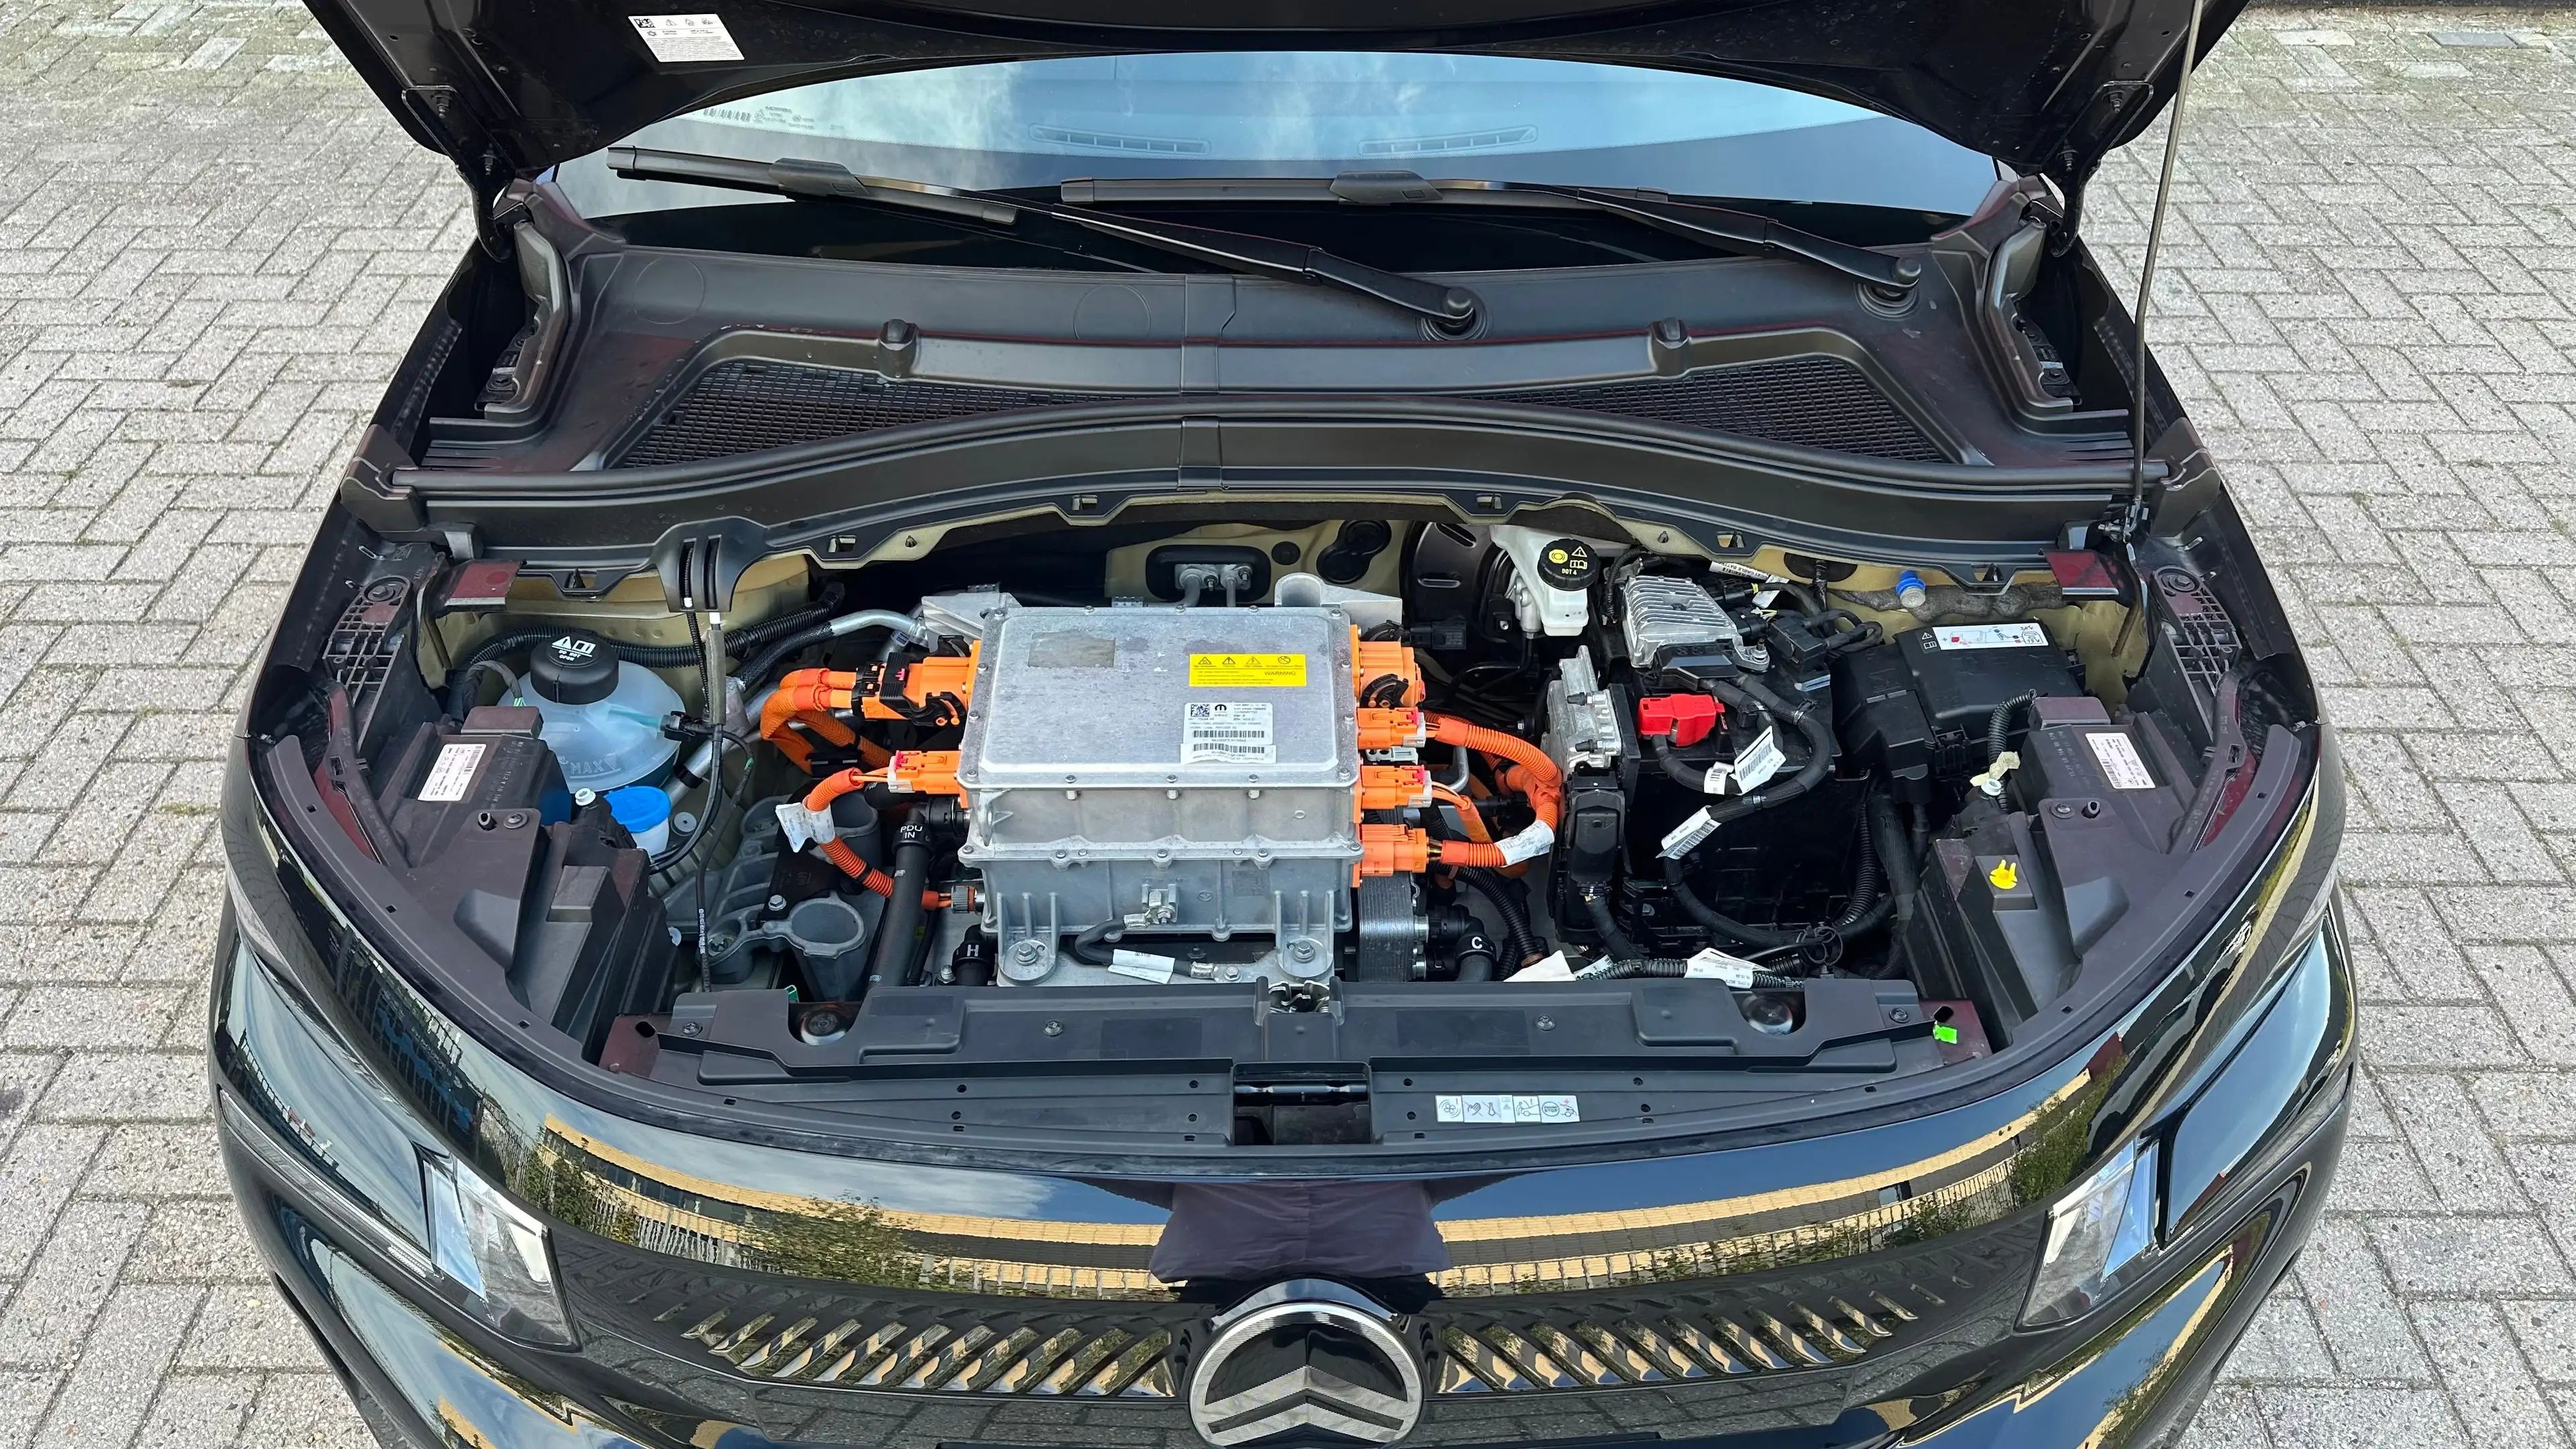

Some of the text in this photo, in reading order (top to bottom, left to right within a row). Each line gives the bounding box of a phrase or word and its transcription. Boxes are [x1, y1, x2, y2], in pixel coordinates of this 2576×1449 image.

[570, 759, 604, 775] MAX
[900, 825, 923, 833] PDU
[1472, 936, 1483, 949] C
[967, 945, 979, 957] H
